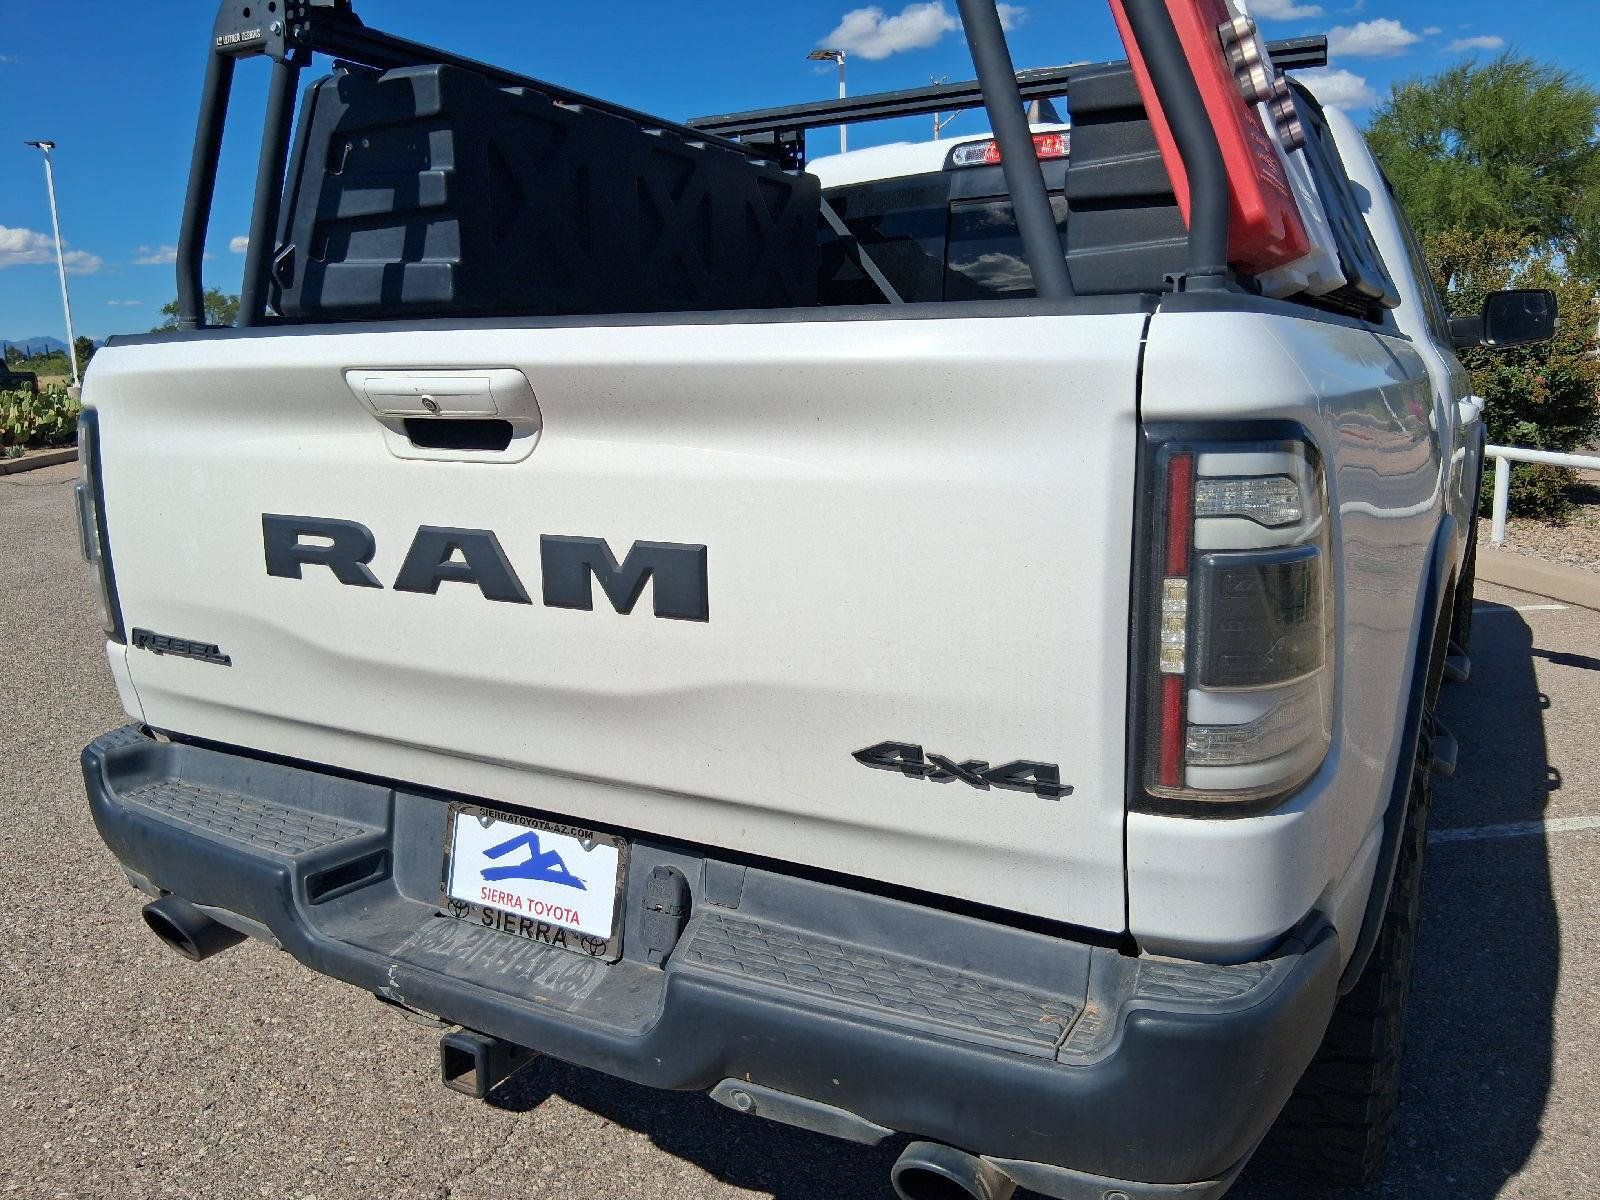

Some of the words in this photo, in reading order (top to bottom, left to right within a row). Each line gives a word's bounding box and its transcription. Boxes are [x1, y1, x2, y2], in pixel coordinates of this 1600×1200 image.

[262, 512, 709, 623] RAM
[132, 627, 232, 667] REBEL
[480, 807, 594, 840] SIERRATOYOTA-AZ.COM
[481, 886, 523, 910] SIERRA
[527, 898, 580, 926] TOYOTA
[481, 907, 568, 949] SIERRA
